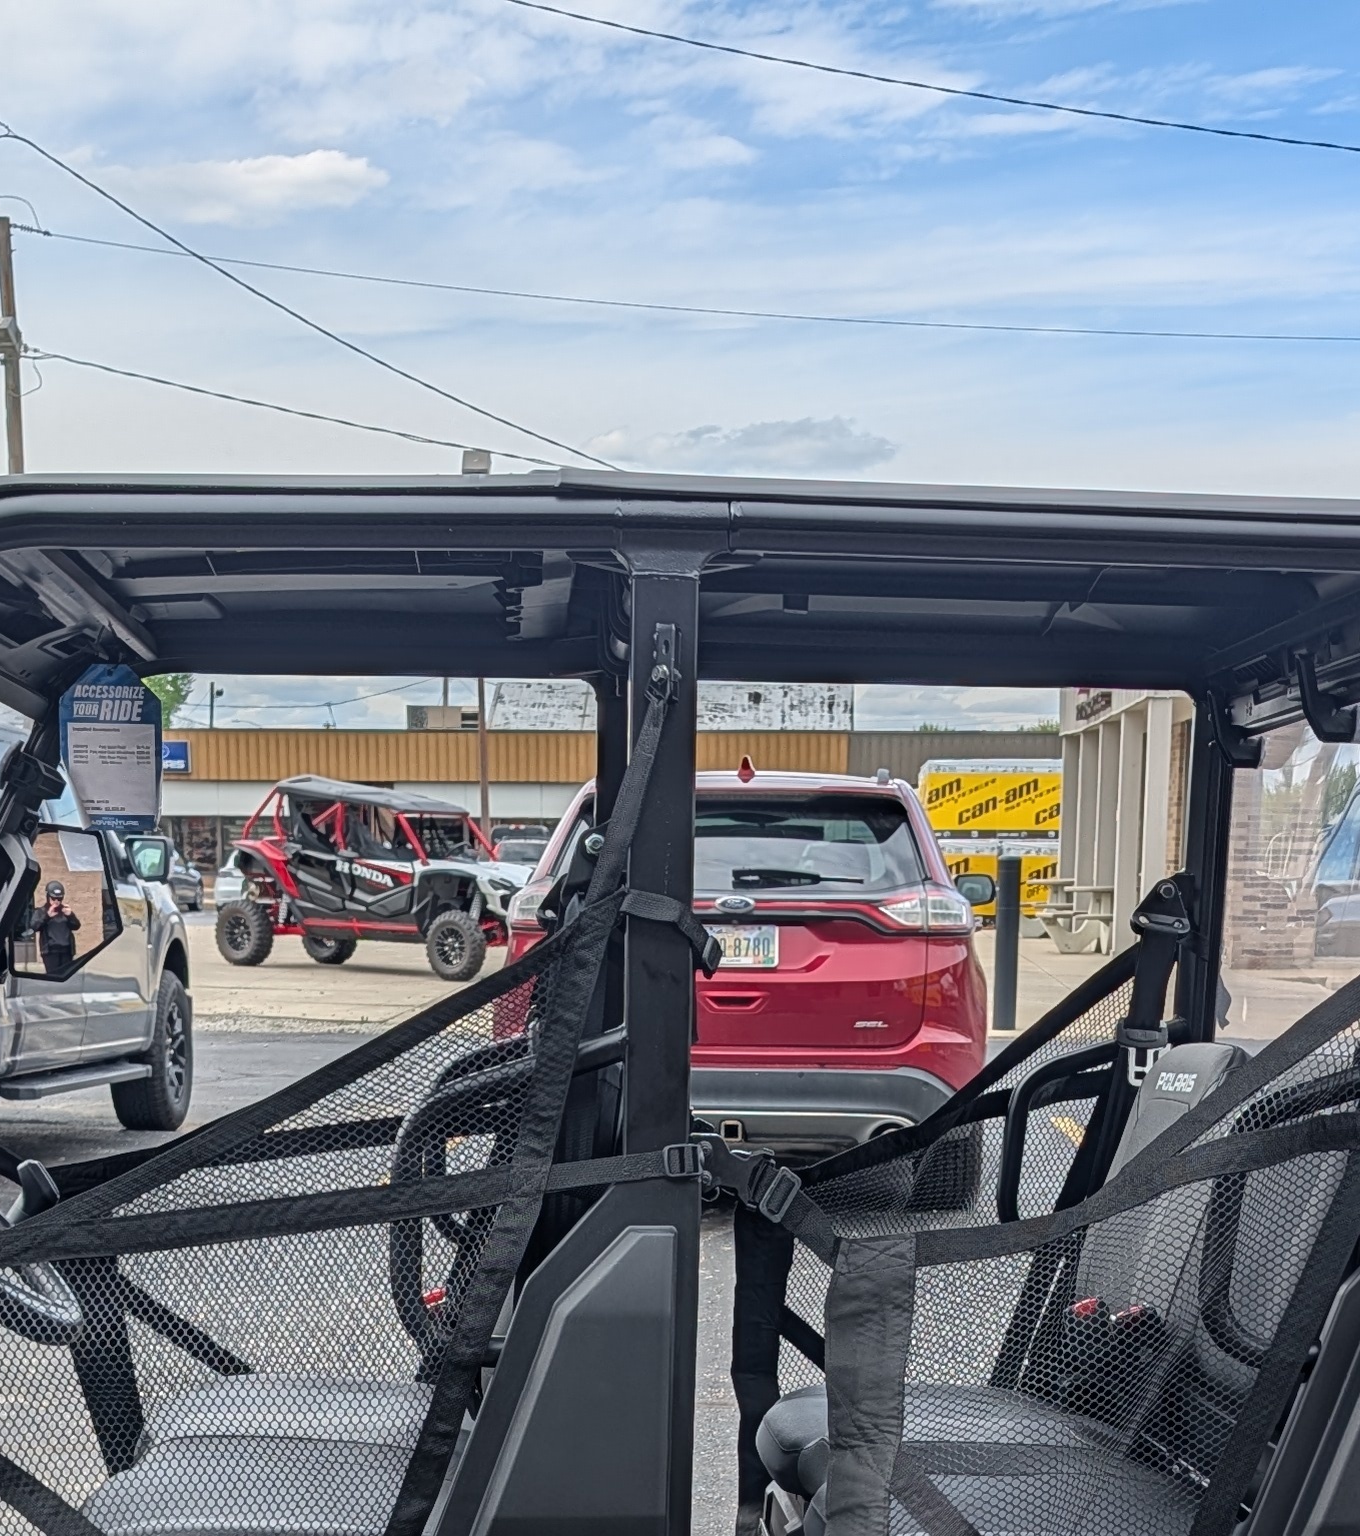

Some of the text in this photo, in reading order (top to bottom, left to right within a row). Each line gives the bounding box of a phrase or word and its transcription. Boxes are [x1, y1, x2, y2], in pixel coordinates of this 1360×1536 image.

[73, 685, 146, 699] ACCESSORIZE
[73, 700, 144, 722] YOUR RIDE
[958, 778, 1039, 826] can-am
[335, 860, 395, 888] HONDA
[1155, 1072, 1197, 1093] POLARIS
